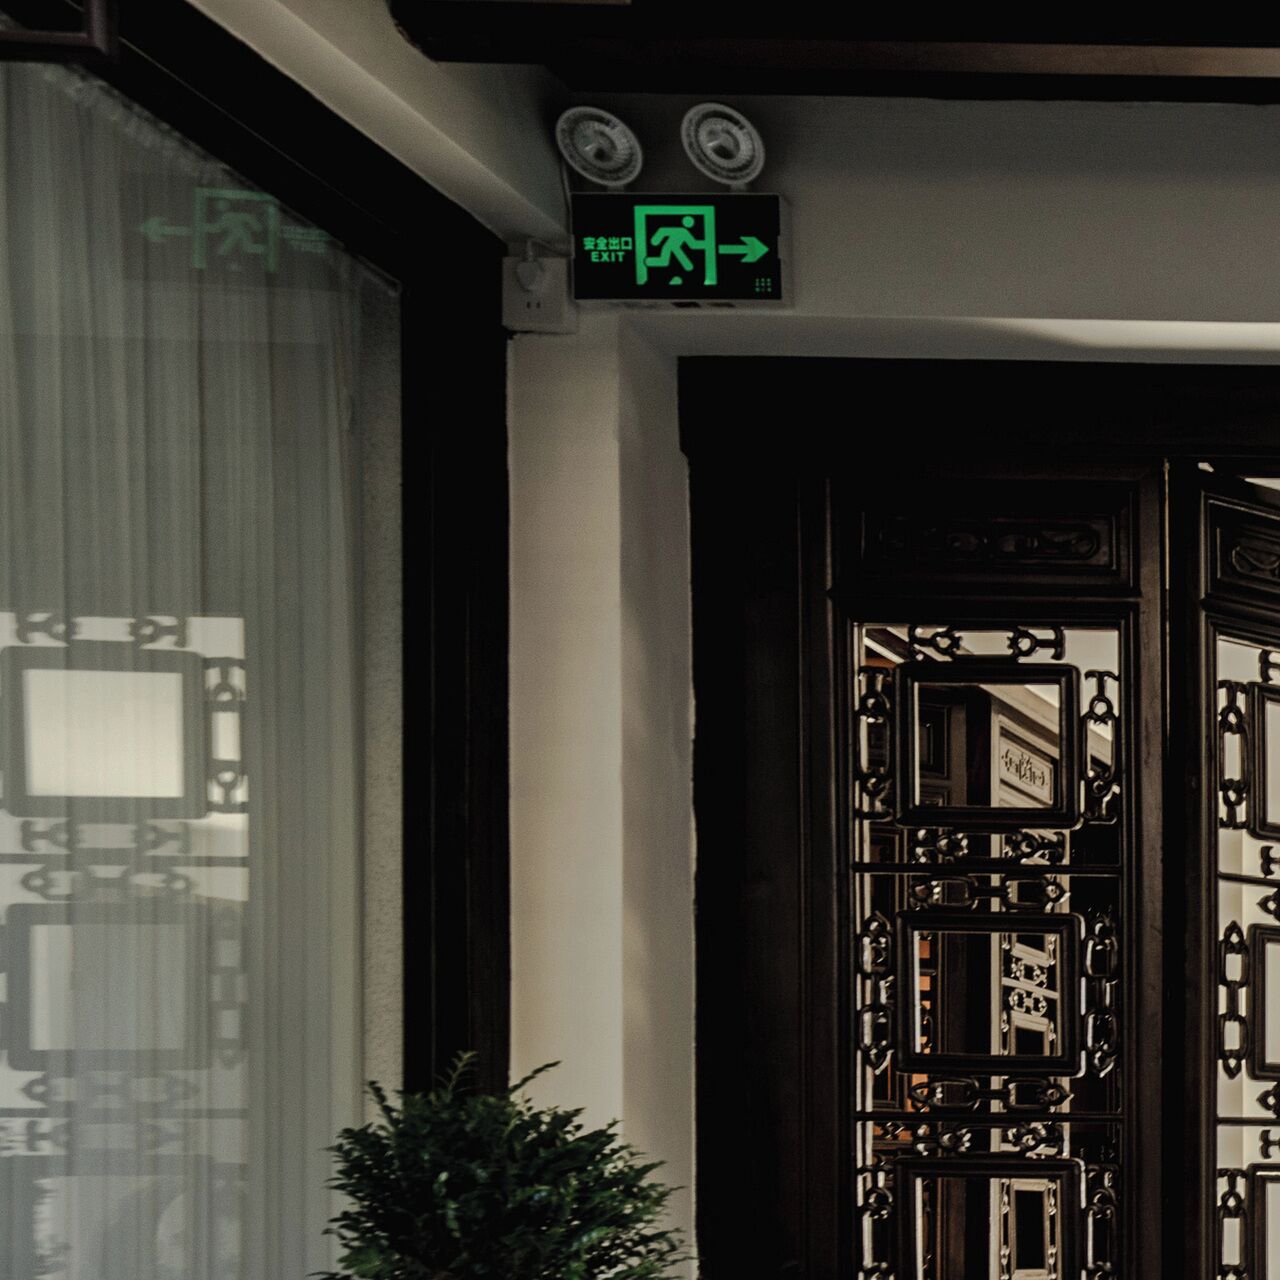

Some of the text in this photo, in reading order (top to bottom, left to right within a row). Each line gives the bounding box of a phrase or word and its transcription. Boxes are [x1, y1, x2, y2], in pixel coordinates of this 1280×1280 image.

[582, 236, 633, 251] 安全出口
[590, 251, 625, 262] EXIT
